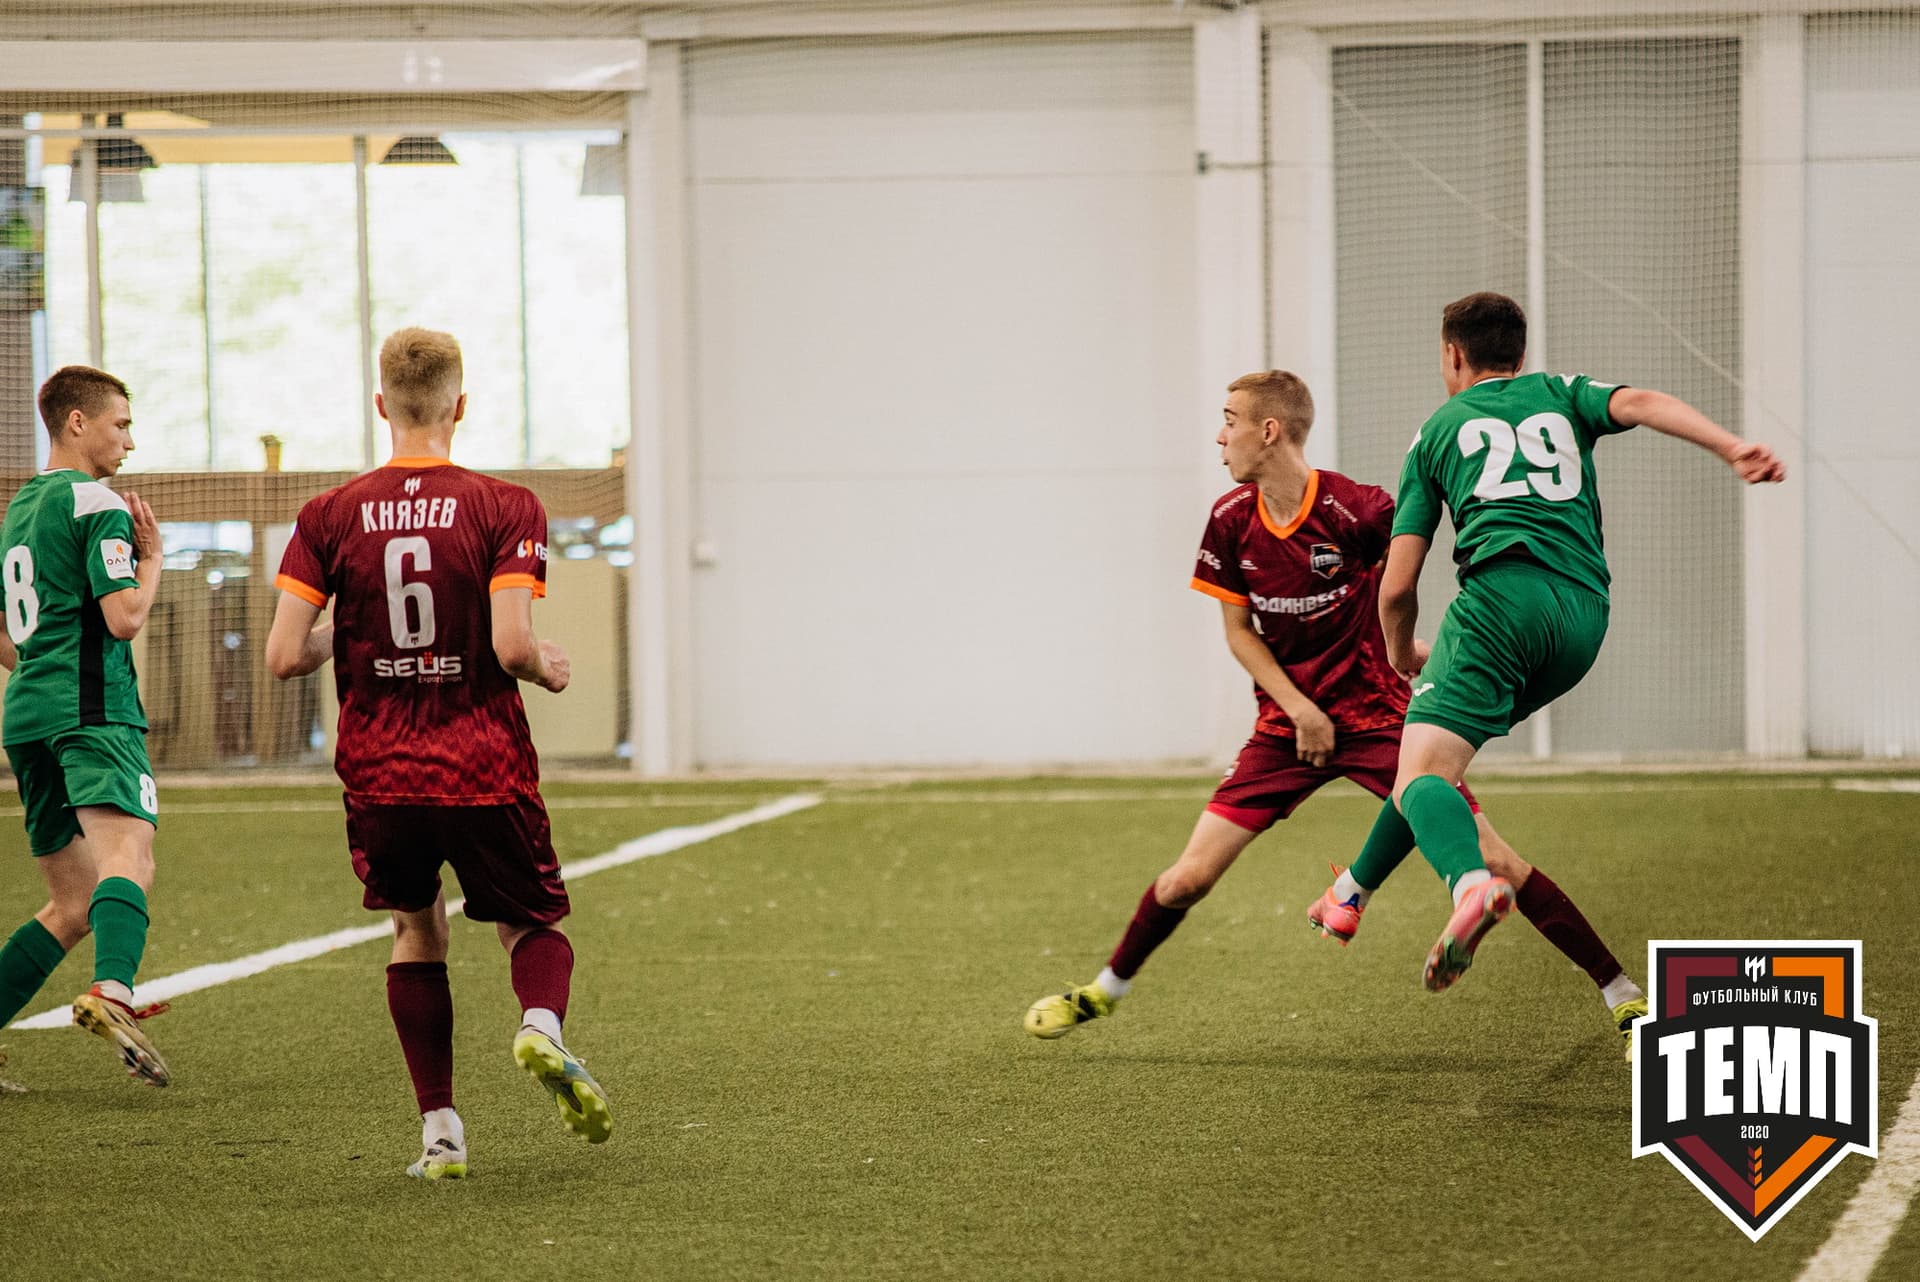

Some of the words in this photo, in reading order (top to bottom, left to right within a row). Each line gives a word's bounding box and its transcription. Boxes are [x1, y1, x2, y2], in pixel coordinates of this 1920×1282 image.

[1457, 412, 1582, 502] 29
[361, 498, 457, 533] КНЯЗЕВ
[3, 545, 39, 645] 8
[384, 536, 436, 649] 6
[139, 773, 158, 815] 8
